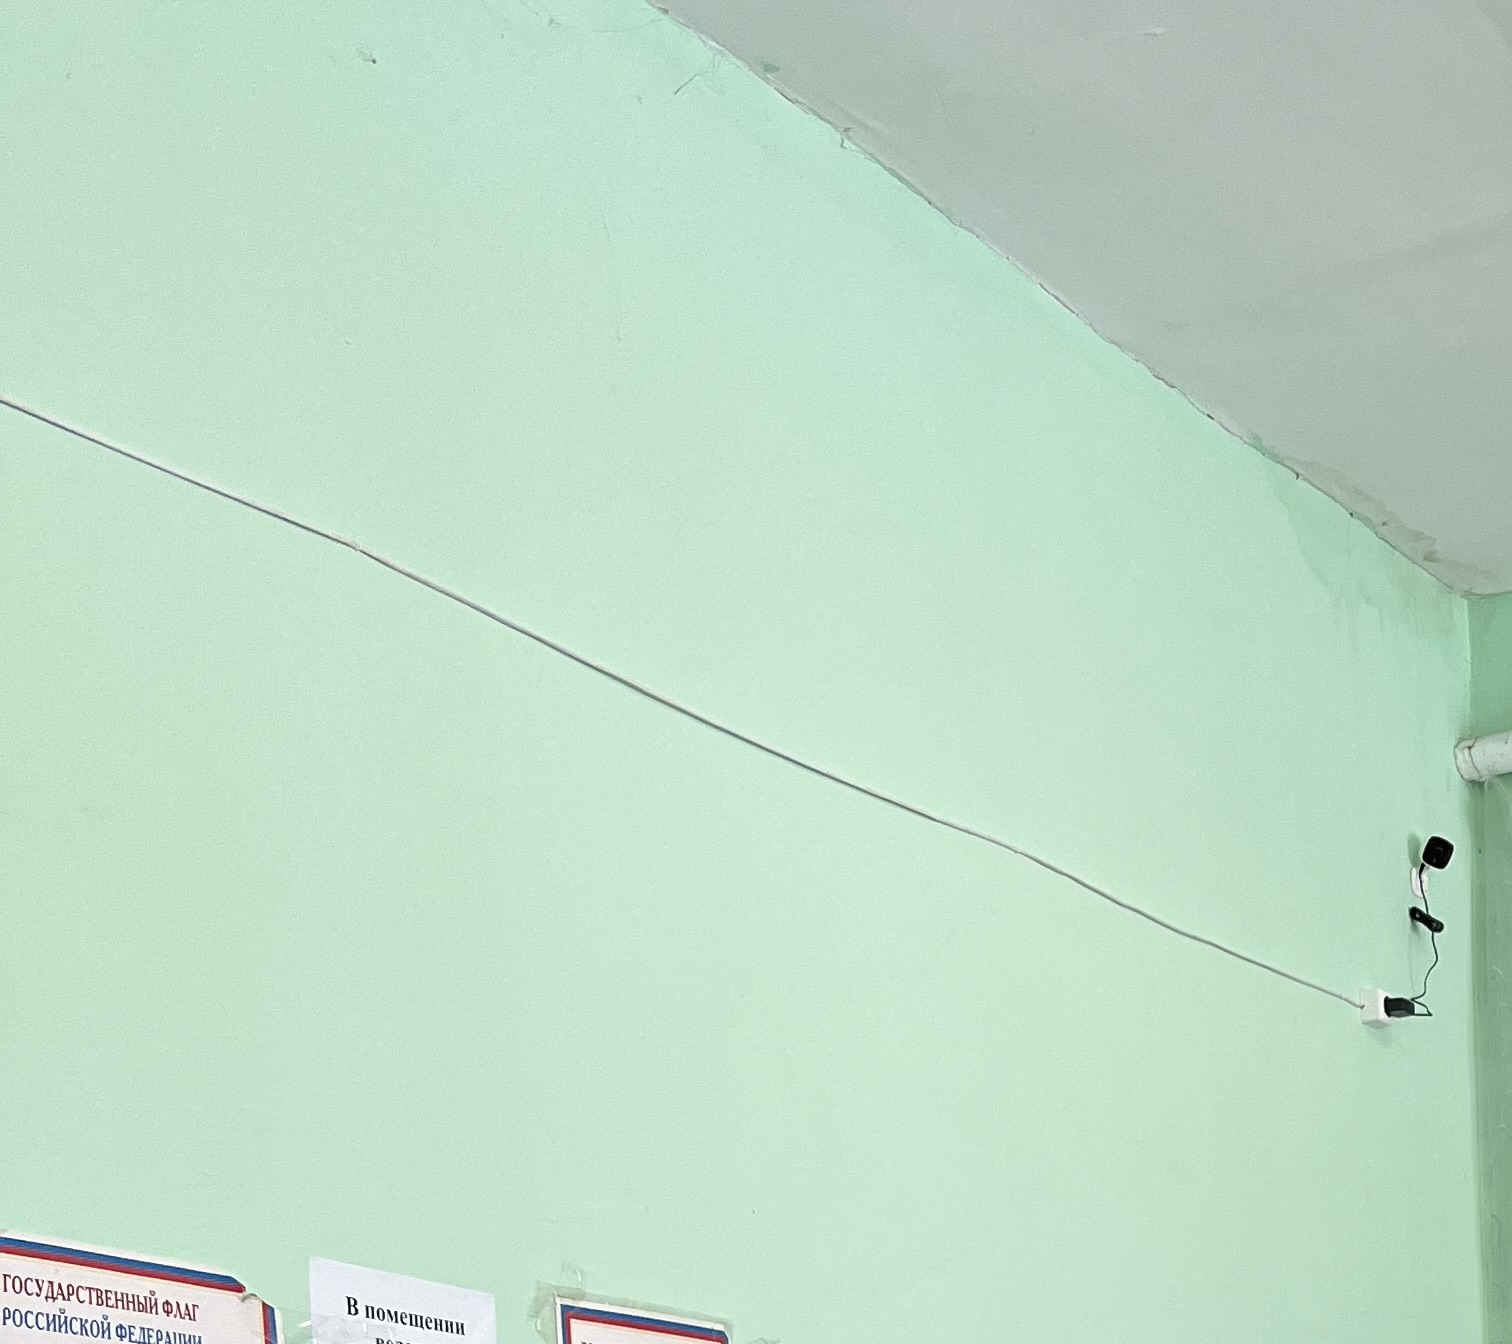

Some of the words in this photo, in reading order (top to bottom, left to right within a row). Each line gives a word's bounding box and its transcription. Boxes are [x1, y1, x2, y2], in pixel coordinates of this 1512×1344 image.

[2, 1273, 160, 1316] ГОСУДАРСТВЕННЫЙ
[162, 1299, 200, 1322] ФЛАГ
[345, 1296, 360, 1316] В
[364, 1304, 466, 1336] помещении
[2, 1307, 112, 1340] РОССИЙСКОЙ
